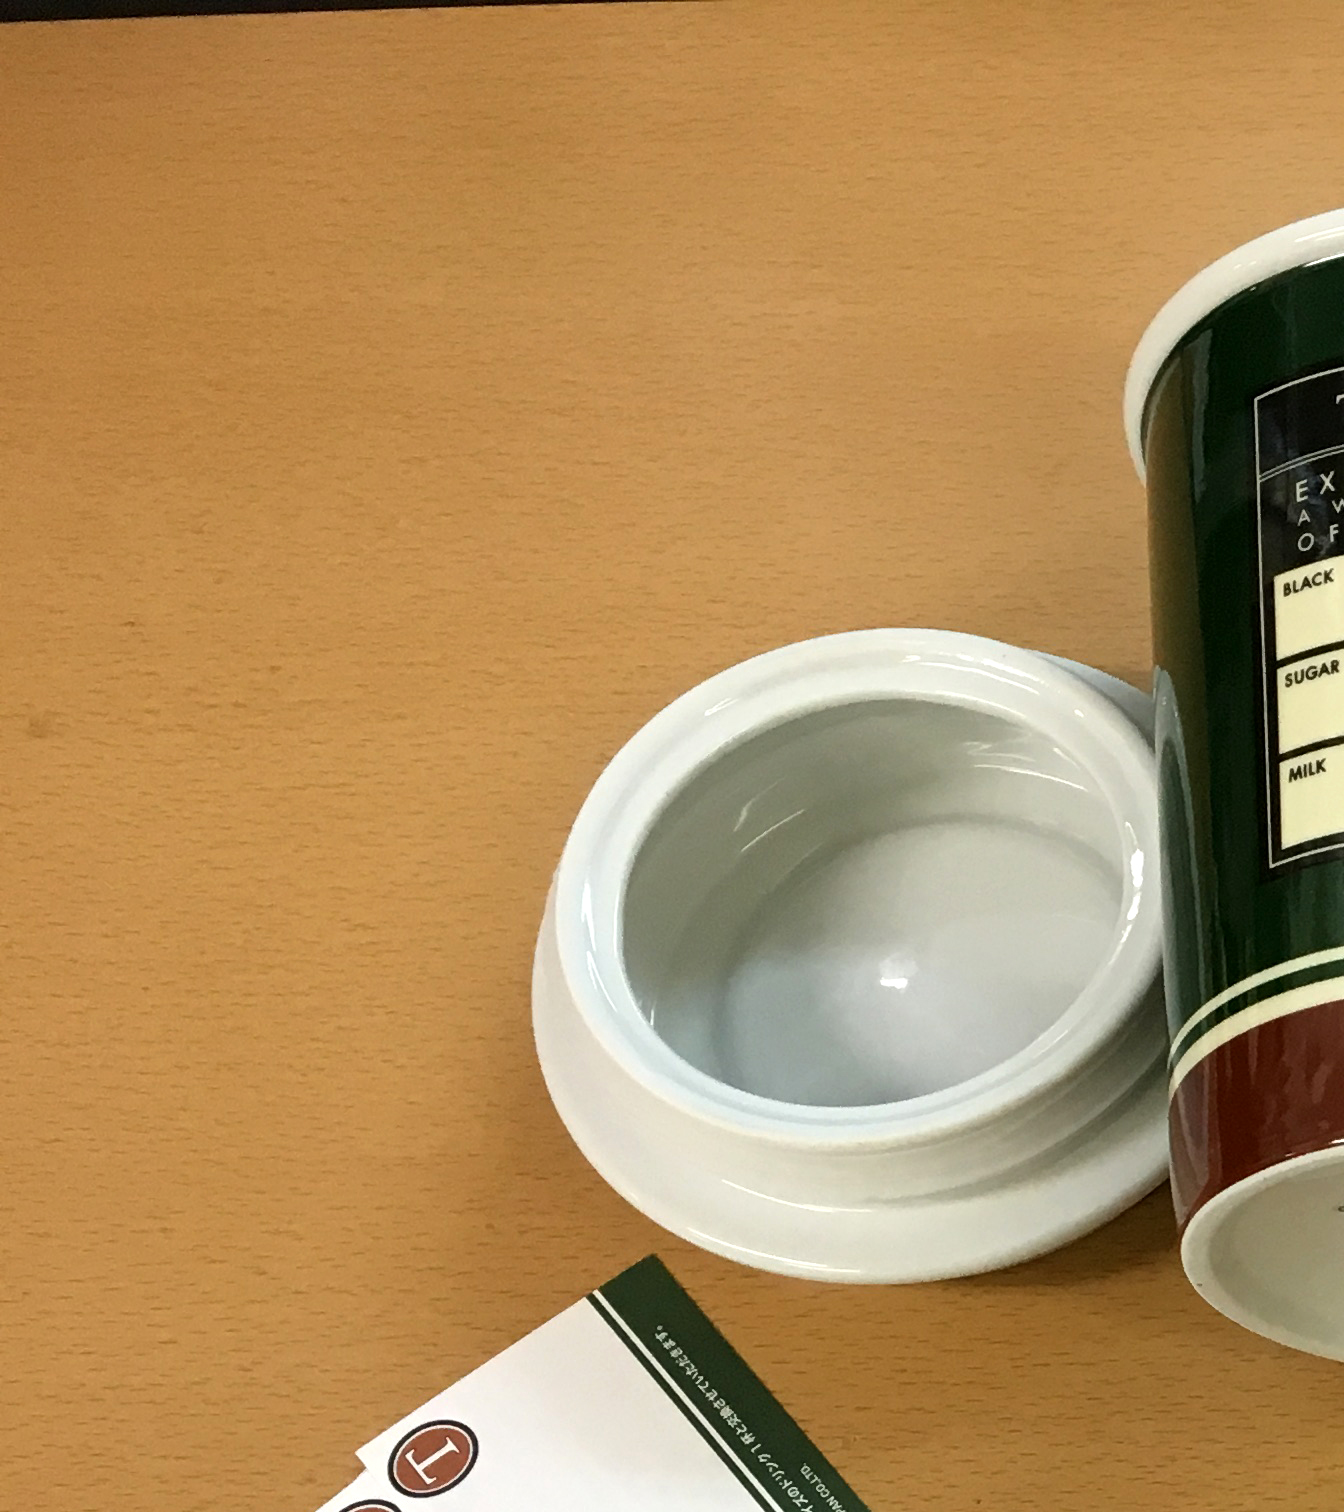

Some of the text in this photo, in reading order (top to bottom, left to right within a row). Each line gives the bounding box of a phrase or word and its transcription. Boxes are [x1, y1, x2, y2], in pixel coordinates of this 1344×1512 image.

[1297, 508, 1311, 526] A
[1297, 524, 1339, 552] OF
[1283, 568, 1334, 598] BLACK
[1285, 659, 1340, 688] SUGAR
[1288, 758, 1326, 783] MILK
[406, 1437, 459, 1485] T
